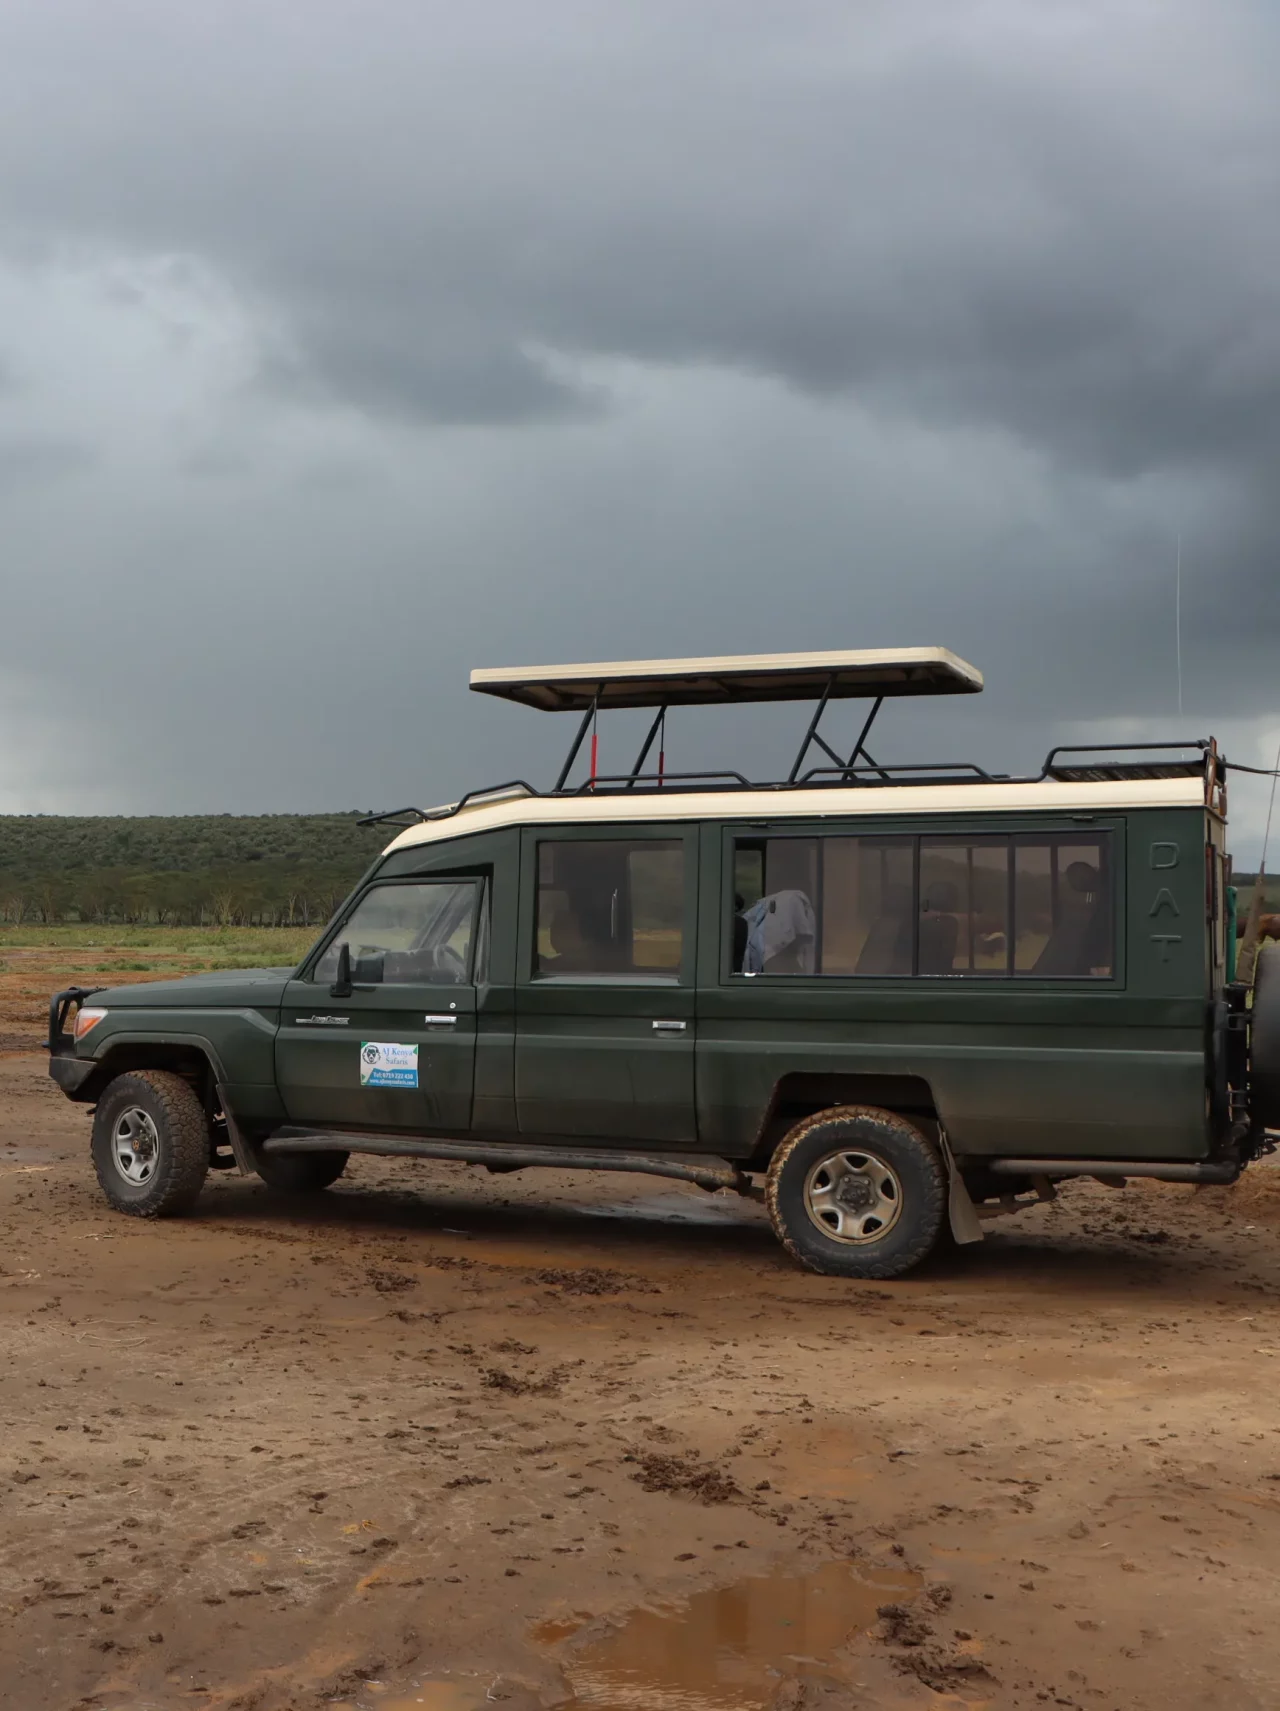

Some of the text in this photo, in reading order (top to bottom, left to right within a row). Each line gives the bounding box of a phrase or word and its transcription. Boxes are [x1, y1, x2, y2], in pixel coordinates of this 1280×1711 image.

[383, 1047, 413, 1057] AJ Kenya
[385, 1057, 408, 1065] Safaris
